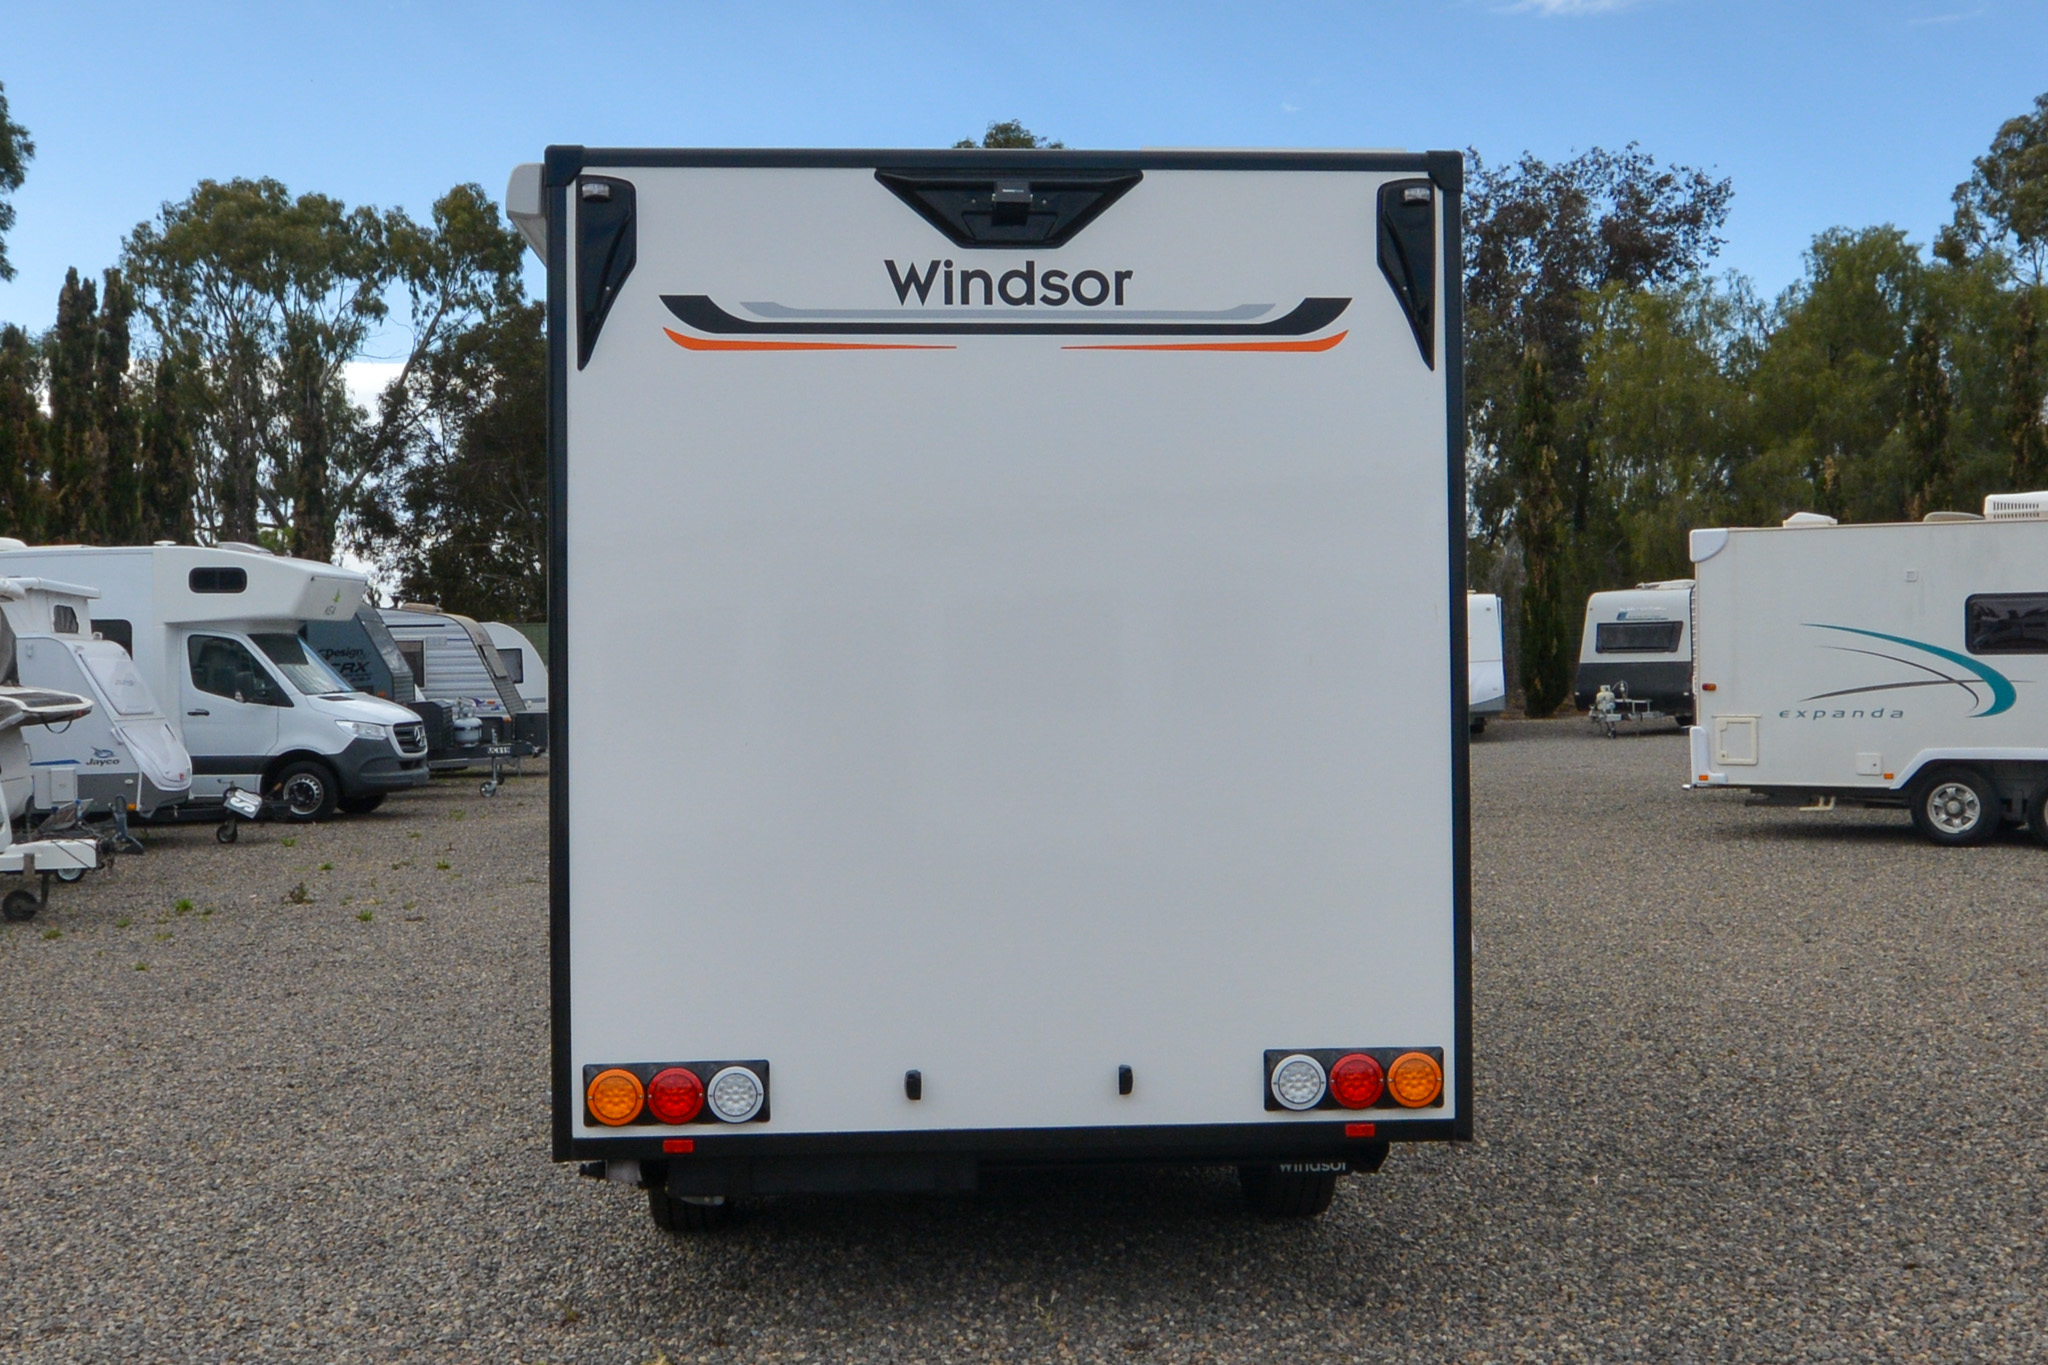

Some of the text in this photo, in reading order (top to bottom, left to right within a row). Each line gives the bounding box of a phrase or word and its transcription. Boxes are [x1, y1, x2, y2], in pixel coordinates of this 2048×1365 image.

[883, 259, 1134, 307] Windsor
[1779, 707, 1904, 720] expanda
[86, 758, 120, 767] Jayco
